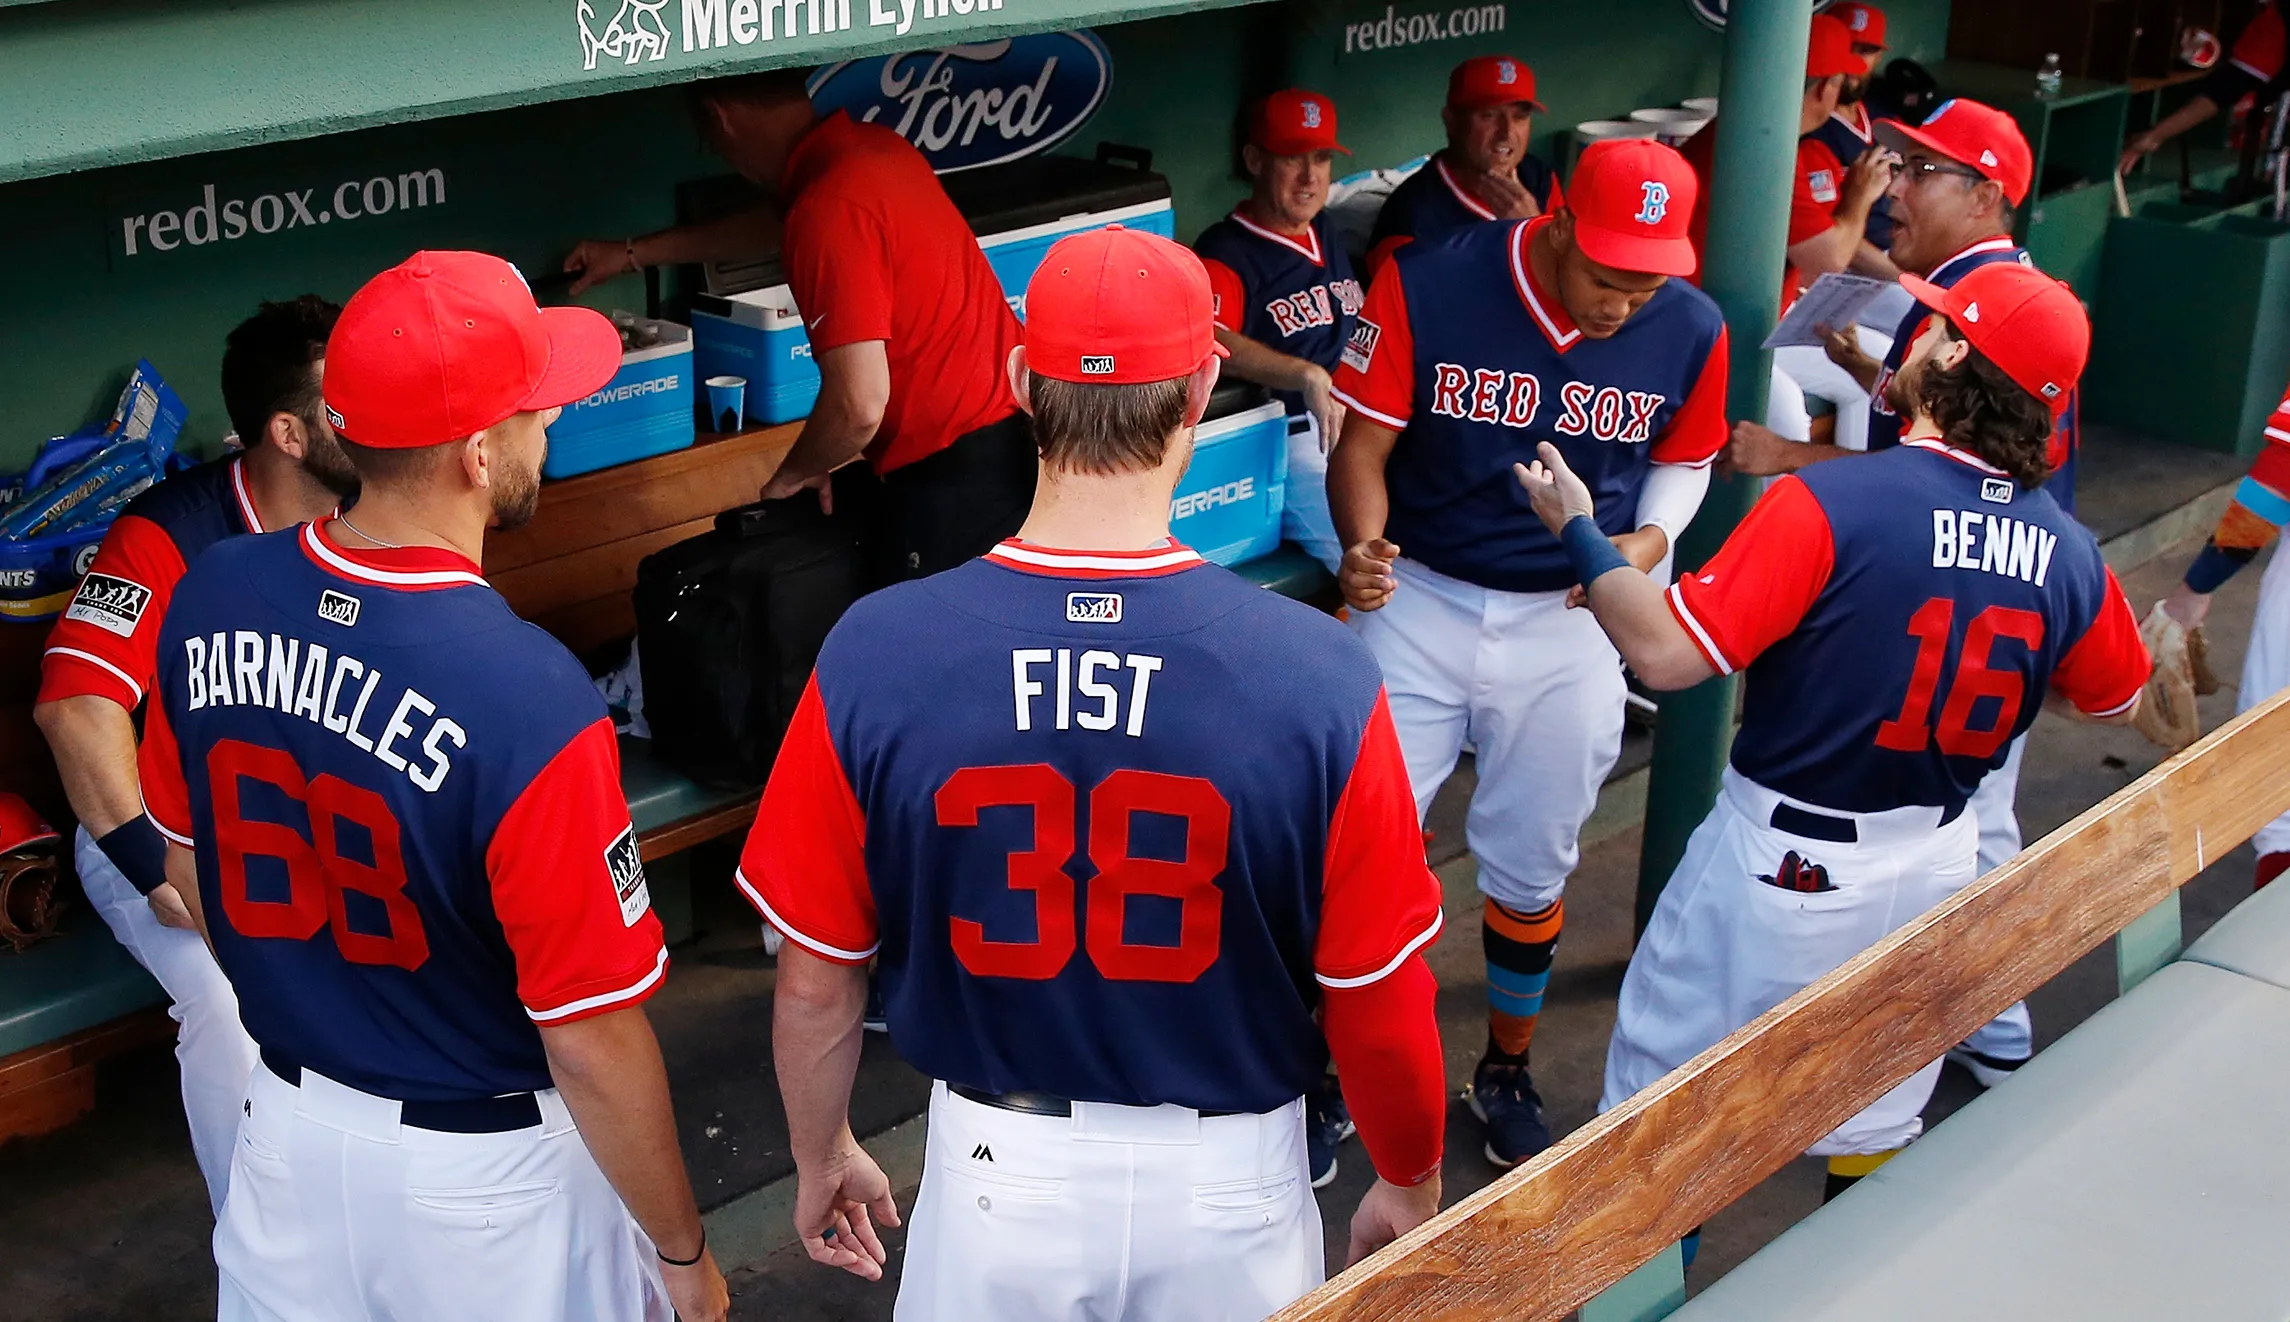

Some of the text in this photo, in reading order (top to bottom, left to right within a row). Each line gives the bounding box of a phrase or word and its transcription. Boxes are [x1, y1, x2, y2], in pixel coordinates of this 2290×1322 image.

[1345, 4, 1506, 53] redsox.com
[862, 38, 1058, 151] Ford
[1301, 100, 1322, 128] B
[1497, 60, 1518, 85] B
[123, 167, 446, 256] redsox.com
[1634, 180, 1671, 225] B
[575, 374, 680, 411] POWERADE
[1431, 362, 1666, 443] RED SOX
[1931, 507, 2058, 588] BENNY
[186, 629, 468, 793] BARNACLES
[1010, 647, 1164, 737] FIST
[1873, 597, 2046, 759] 16
[206, 737, 431, 972] 68
[934, 762, 1232, 983] 38
